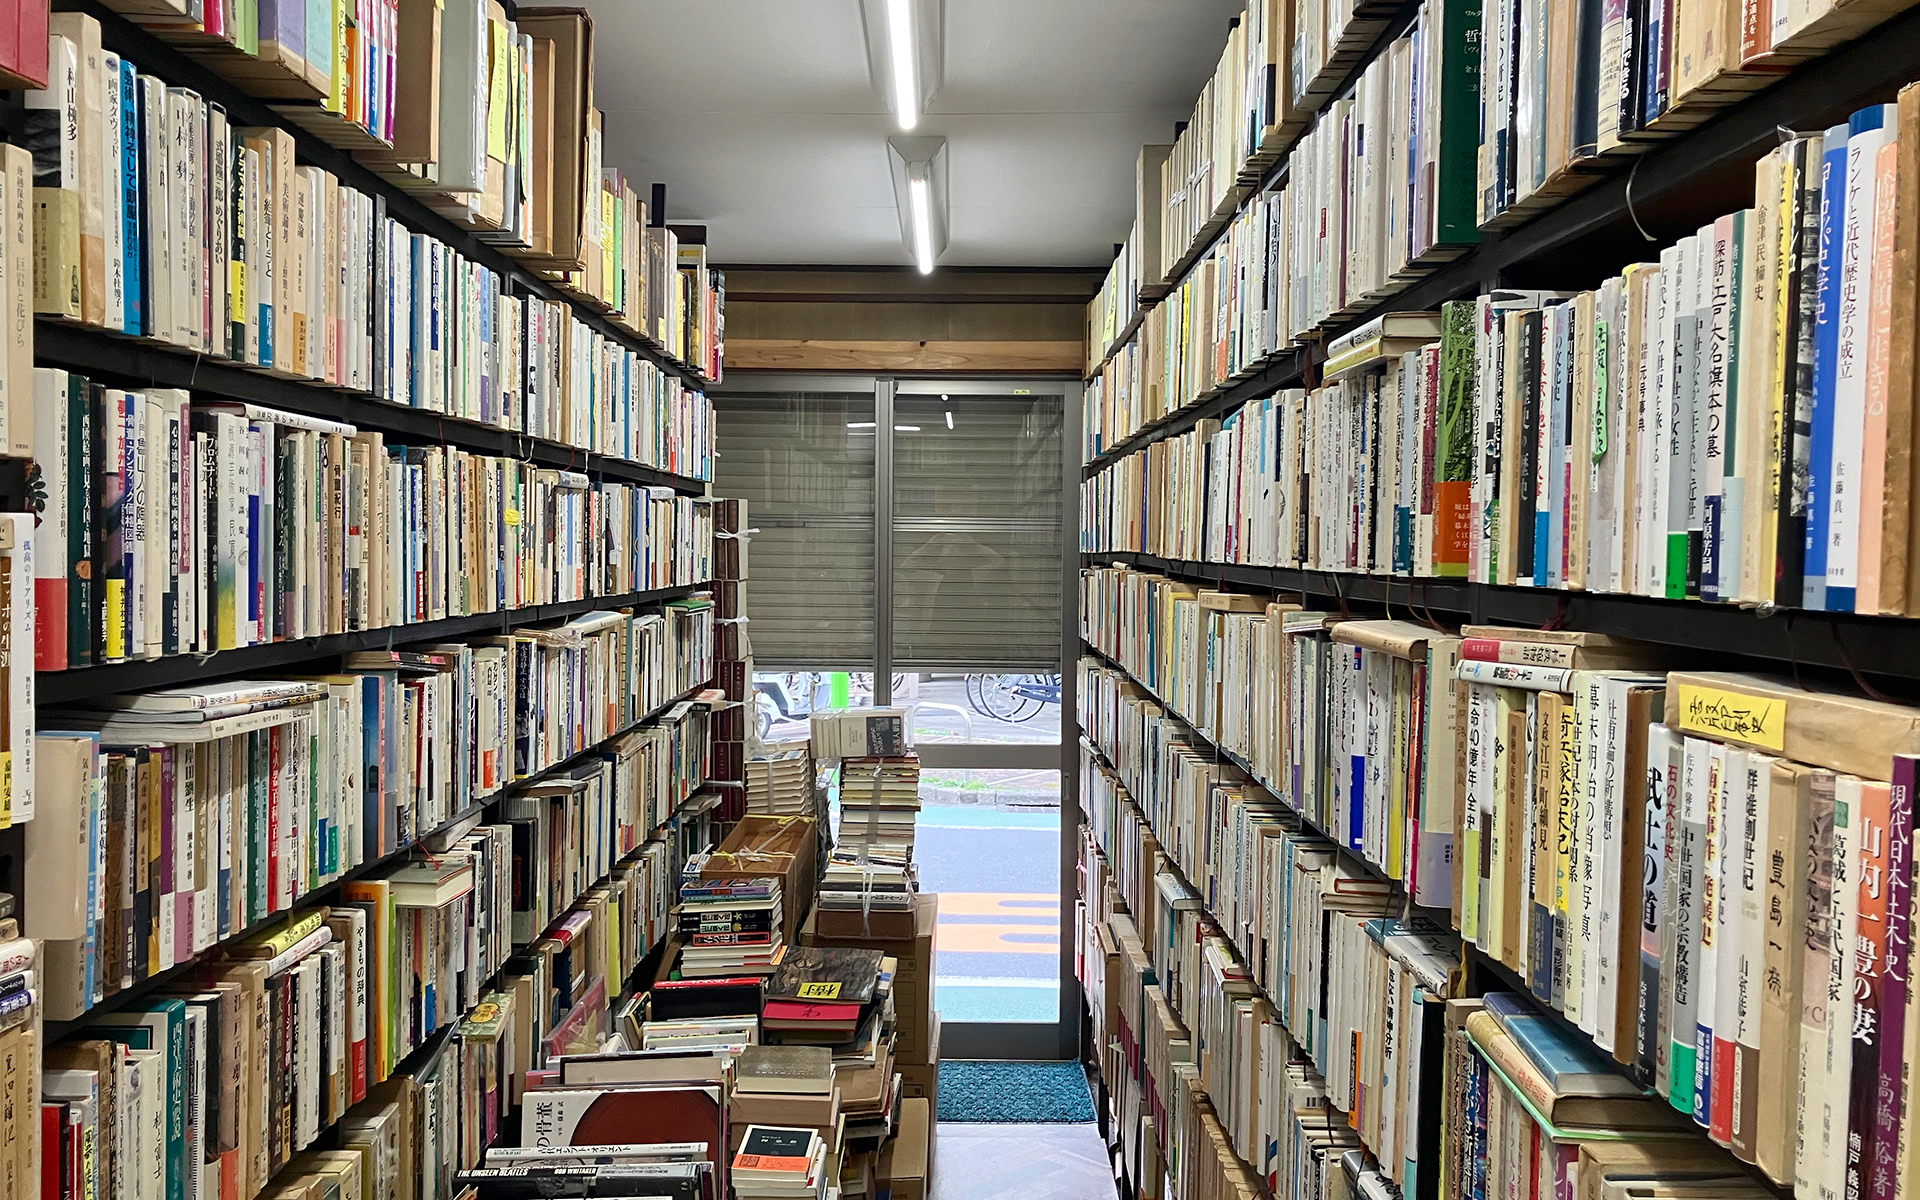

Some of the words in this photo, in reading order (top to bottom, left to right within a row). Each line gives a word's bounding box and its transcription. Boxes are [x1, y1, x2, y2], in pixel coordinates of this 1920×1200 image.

[67, 67, 78, 142] 村山槐多
[1838, 147, 1863, 380] ランケと近代歴史学の成立
[1705, 239, 1728, 459] 探訪・江戸大名旗本の墓
[24, 541, 32, 632] 孤高のリアリズム
[185, 748, 195, 813] 岸田劉生
[1465, 688, 1480, 831] 生命40億年全史
[1664, 763, 1678, 862] 石の文化史
[1643, 766, 1663, 934] 武士の道
[1674, 826, 1694, 1006] 中世国家の宗教構造
[1883, 784, 1912, 982] 現代日本土木史
[1852, 816, 1884, 1046] 山内一豊の妻
[457, 1170, 470, 1178] THE
[470, 1169, 498, 1177] UNSEEN
[498, 1168, 529, 1177] BEATLES
[567, 1167, 597, 1175] WHITAKER
